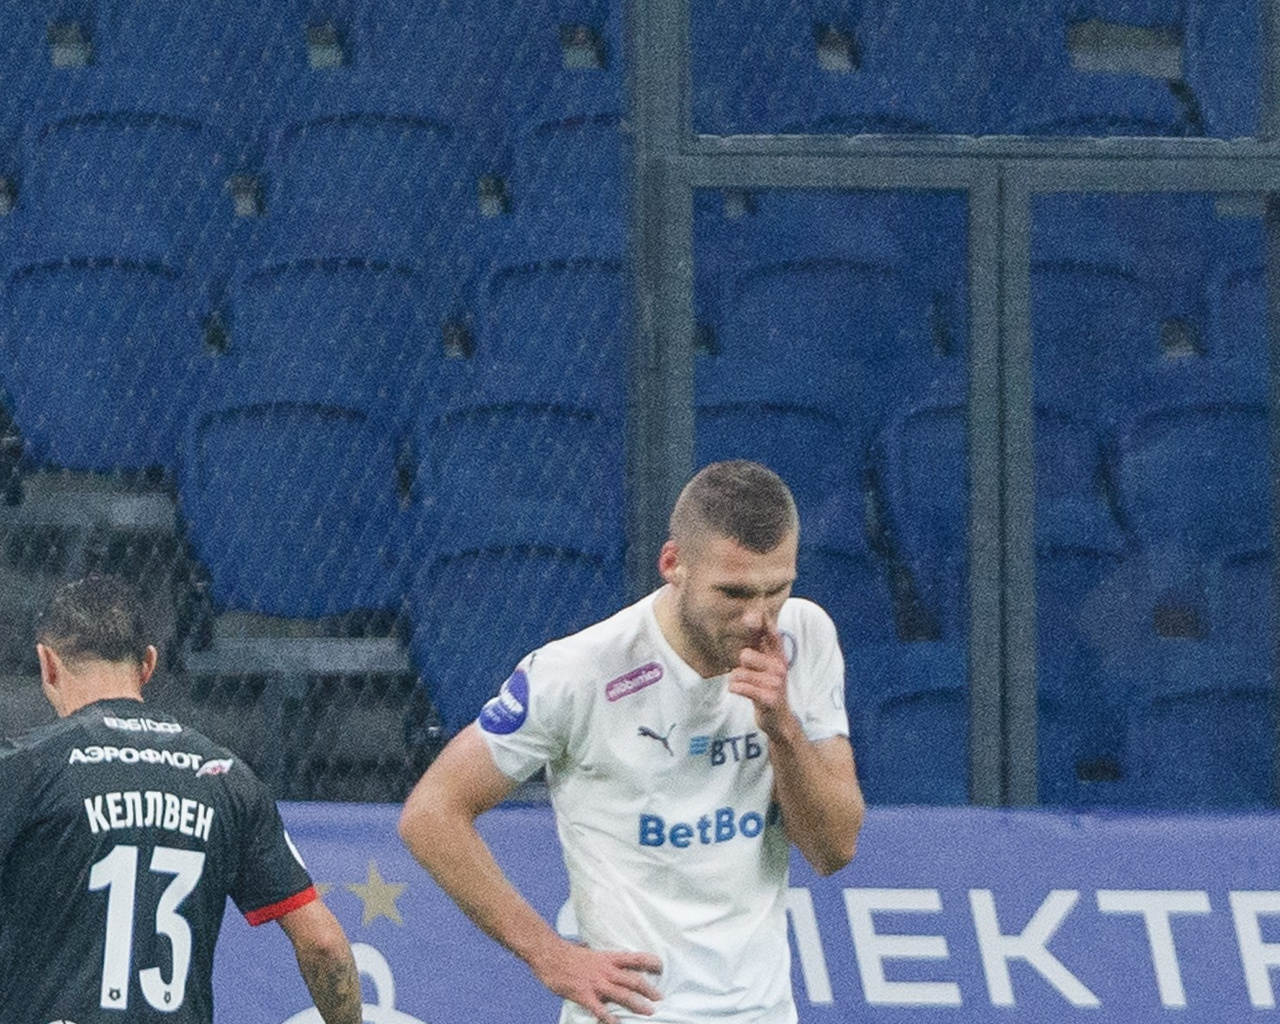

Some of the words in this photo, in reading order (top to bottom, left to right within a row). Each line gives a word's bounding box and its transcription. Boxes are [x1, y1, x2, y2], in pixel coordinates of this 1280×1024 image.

[67, 745, 204, 772] АЭРОФЛОТ
[711, 731, 762, 767] ВТБ
[83, 789, 215, 842] КЕЛЛВЕН
[639, 806, 765, 850] BetBo
[87, 843, 206, 1013] 13
